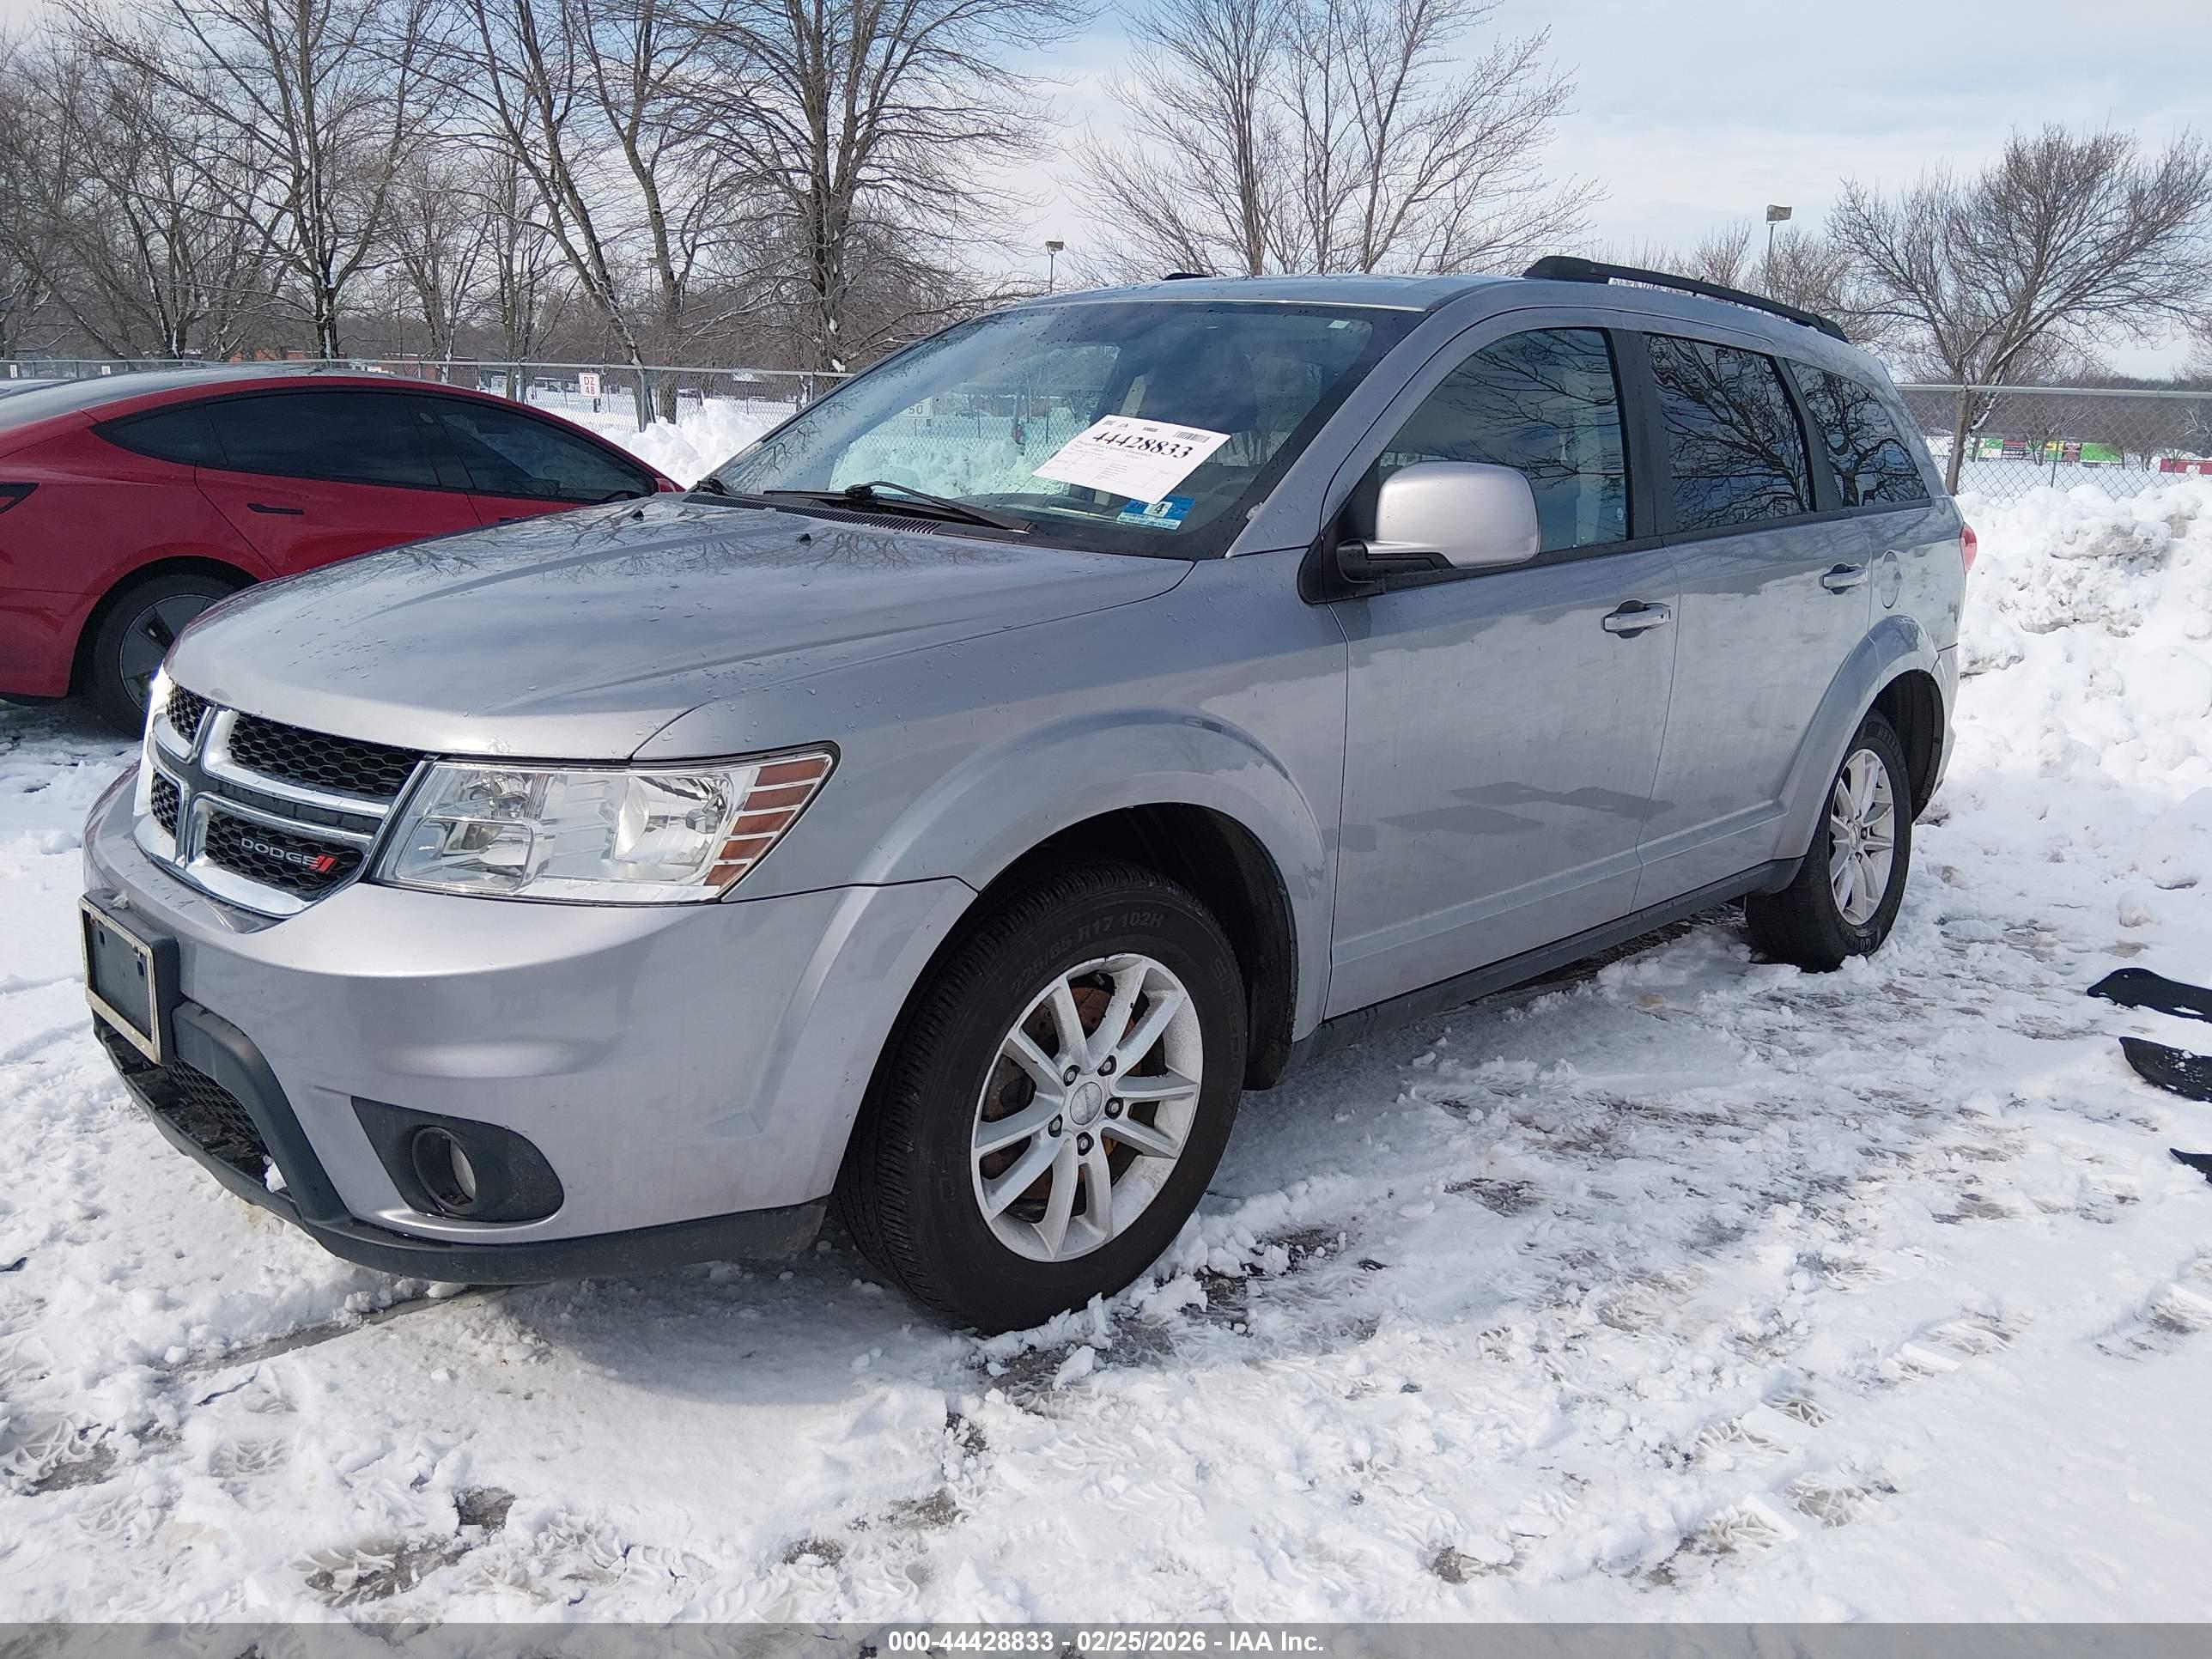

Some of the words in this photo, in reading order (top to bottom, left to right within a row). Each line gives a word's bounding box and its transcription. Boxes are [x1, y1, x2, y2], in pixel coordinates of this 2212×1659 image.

[584, 376, 595, 386] DZ
[585, 386, 595, 395] 48
[1092, 431, 1194, 459] 44428833
[1154, 503, 1165, 514] 4
[241, 838, 319, 868] DODGE
[1078, 916, 1114, 941] R17
[1121, 911, 1164, 928] 102H
